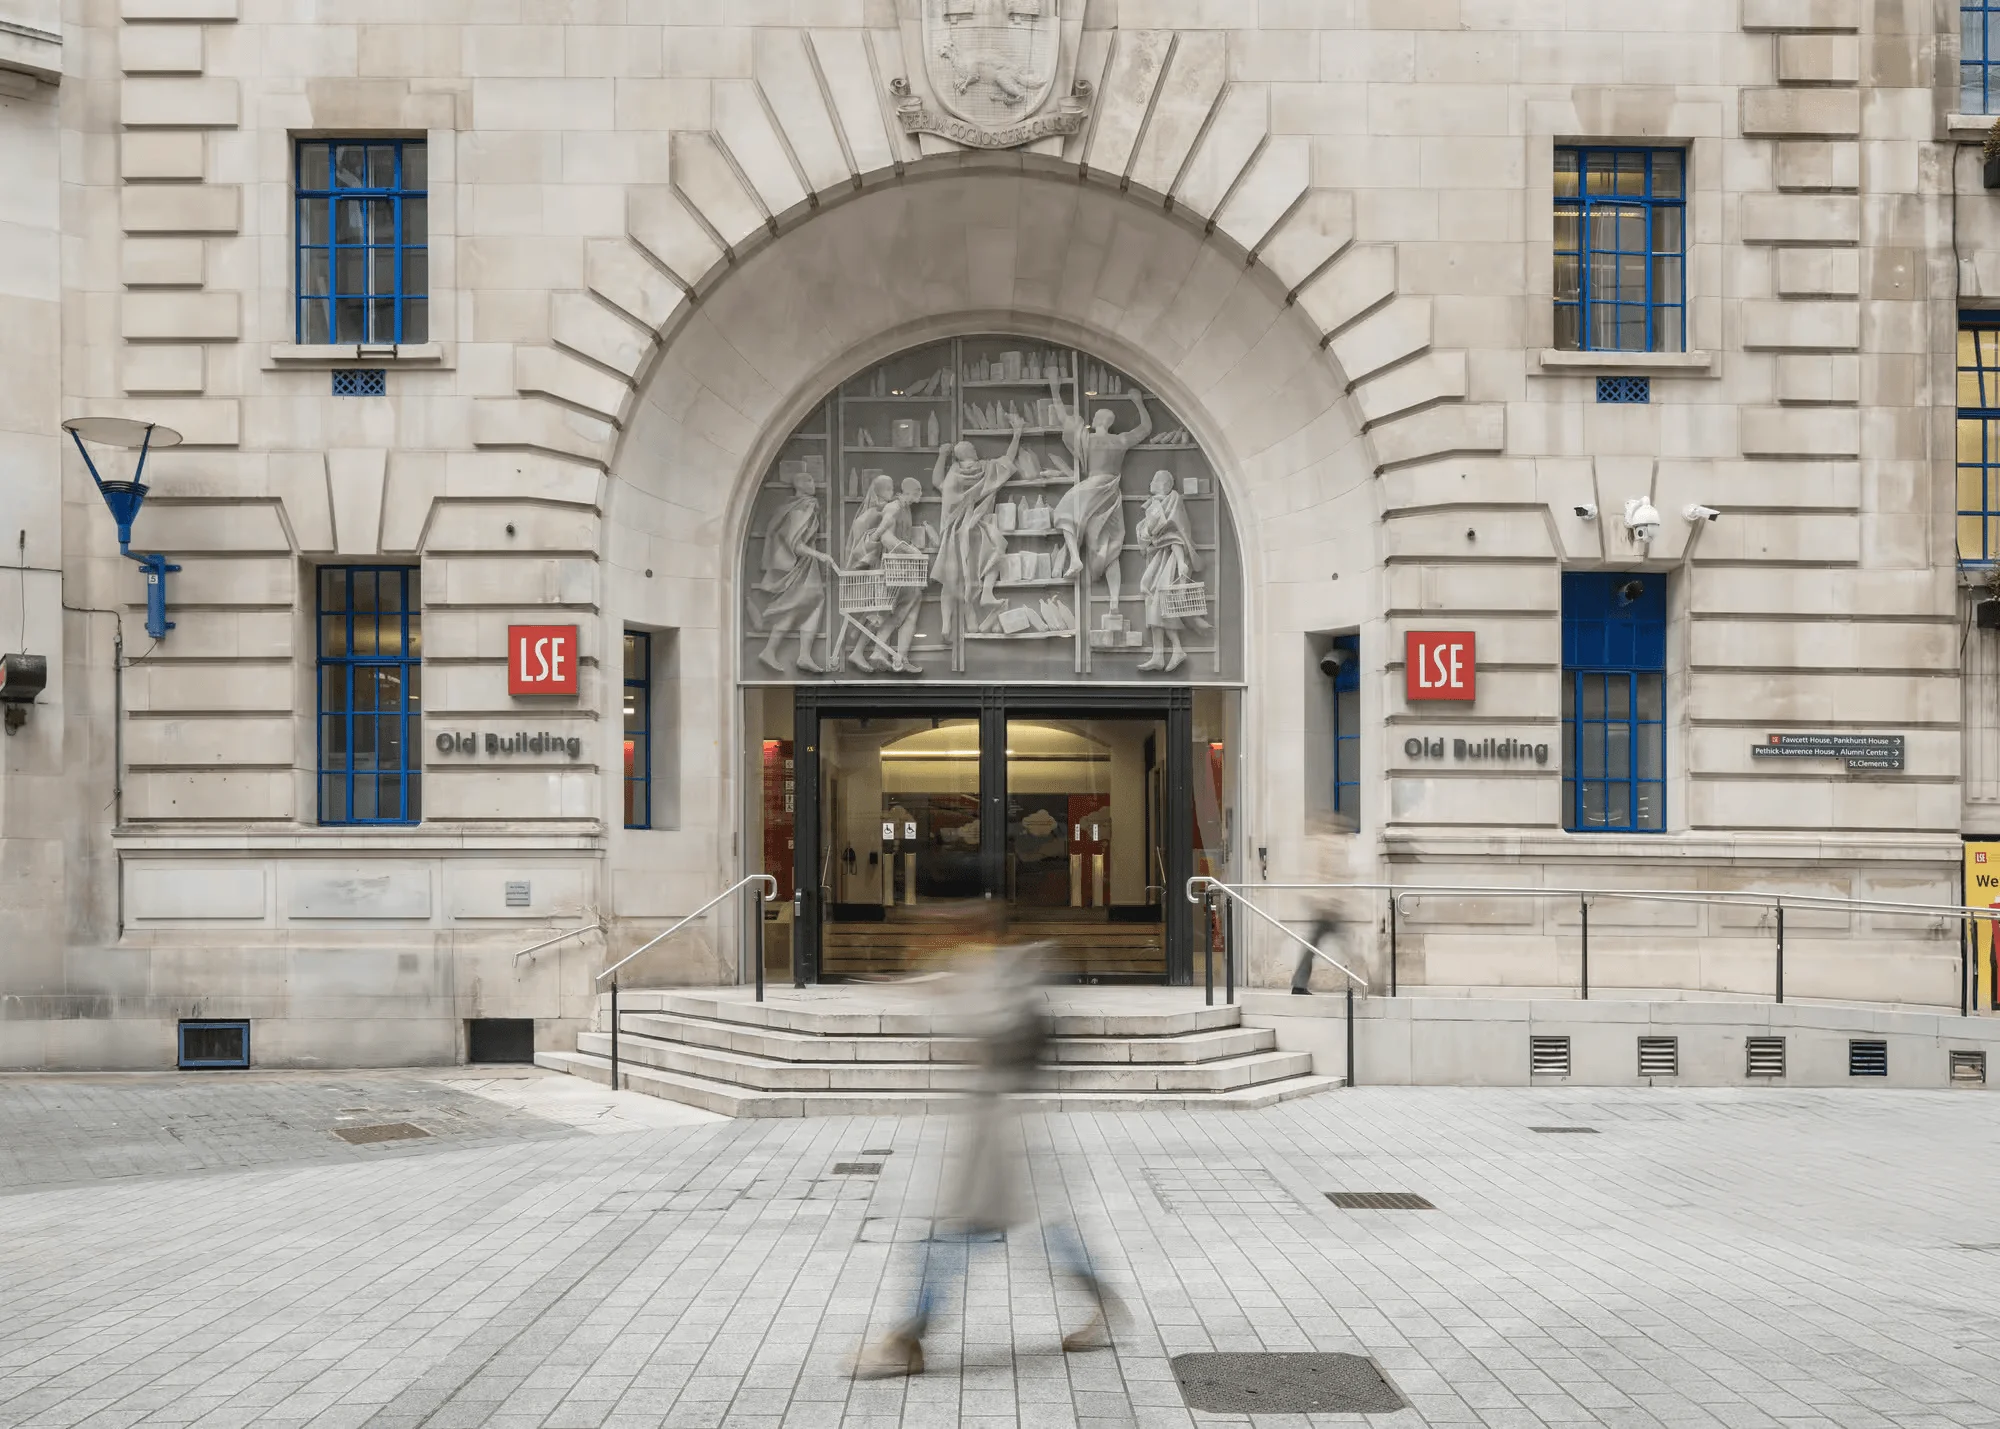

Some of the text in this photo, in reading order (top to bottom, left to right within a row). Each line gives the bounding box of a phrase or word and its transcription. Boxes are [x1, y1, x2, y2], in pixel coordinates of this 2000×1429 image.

[150, 575, 156, 583] 5
[520, 637, 565, 682] LSE
[1419, 643, 1464, 688] LSE
[436, 732, 580, 758] Old Building
[1809, 736, 1832, 745] House,
[1868, 737, 1889, 745] House
[1404, 737, 1548, 764] Old Building
[1840, 748, 1865, 756] Alumni
[1976, 853, 1986, 862] LSE
